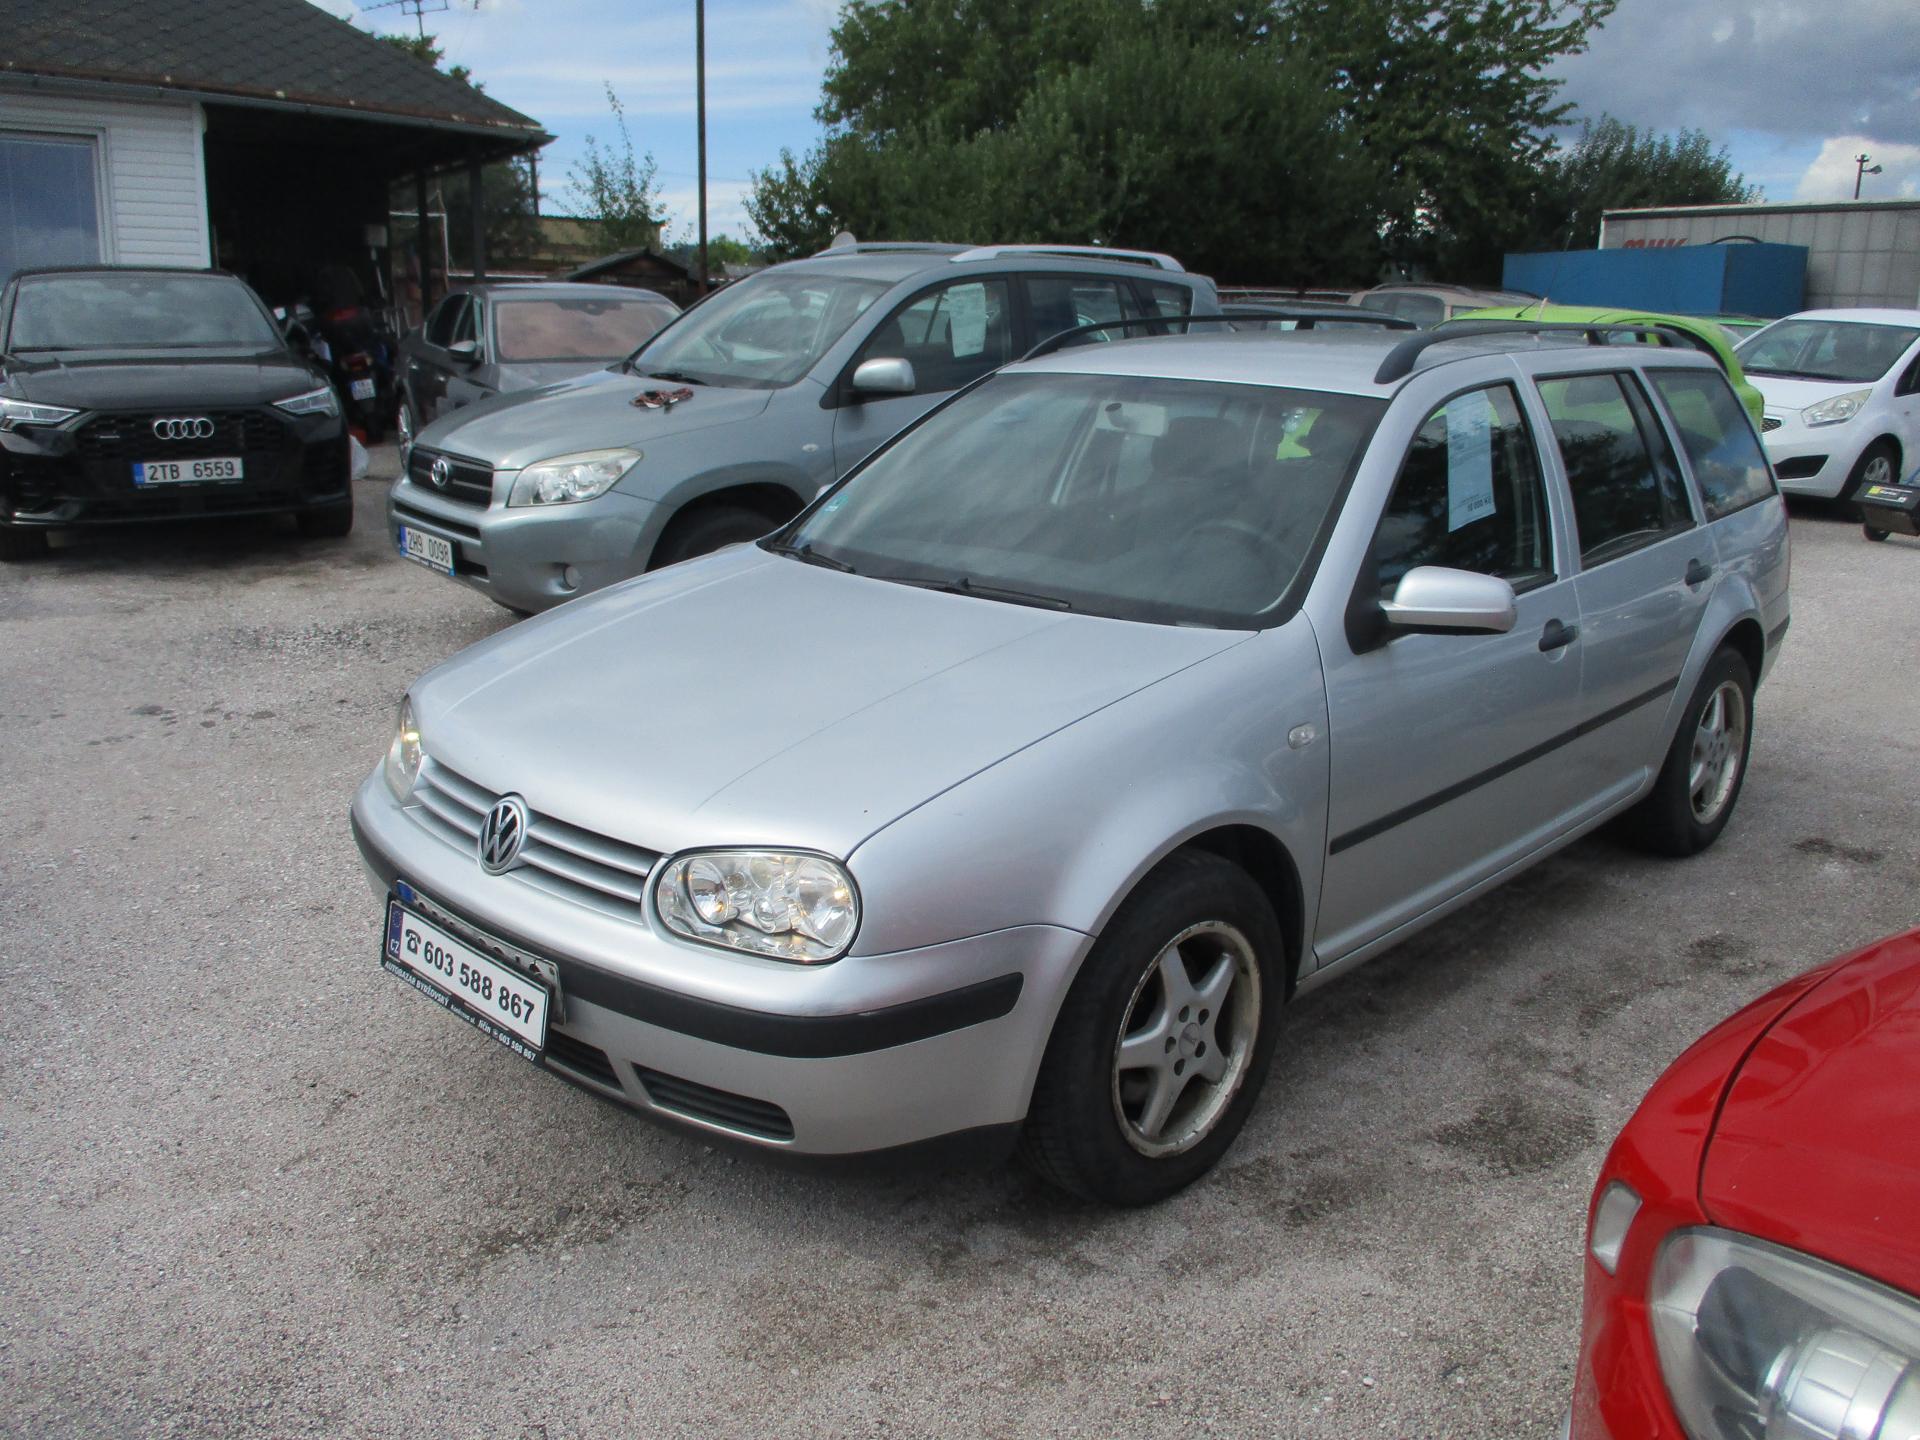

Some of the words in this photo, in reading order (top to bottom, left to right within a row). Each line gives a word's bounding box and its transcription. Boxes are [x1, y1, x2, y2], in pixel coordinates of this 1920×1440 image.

[148, 464, 180, 481] 2TB
[193, 460, 235, 478] 6559
[390, 938, 400, 954] CZ
[424, 941, 454, 977] 603
[459, 962, 493, 1001] 588
[499, 985, 535, 1024] 867
